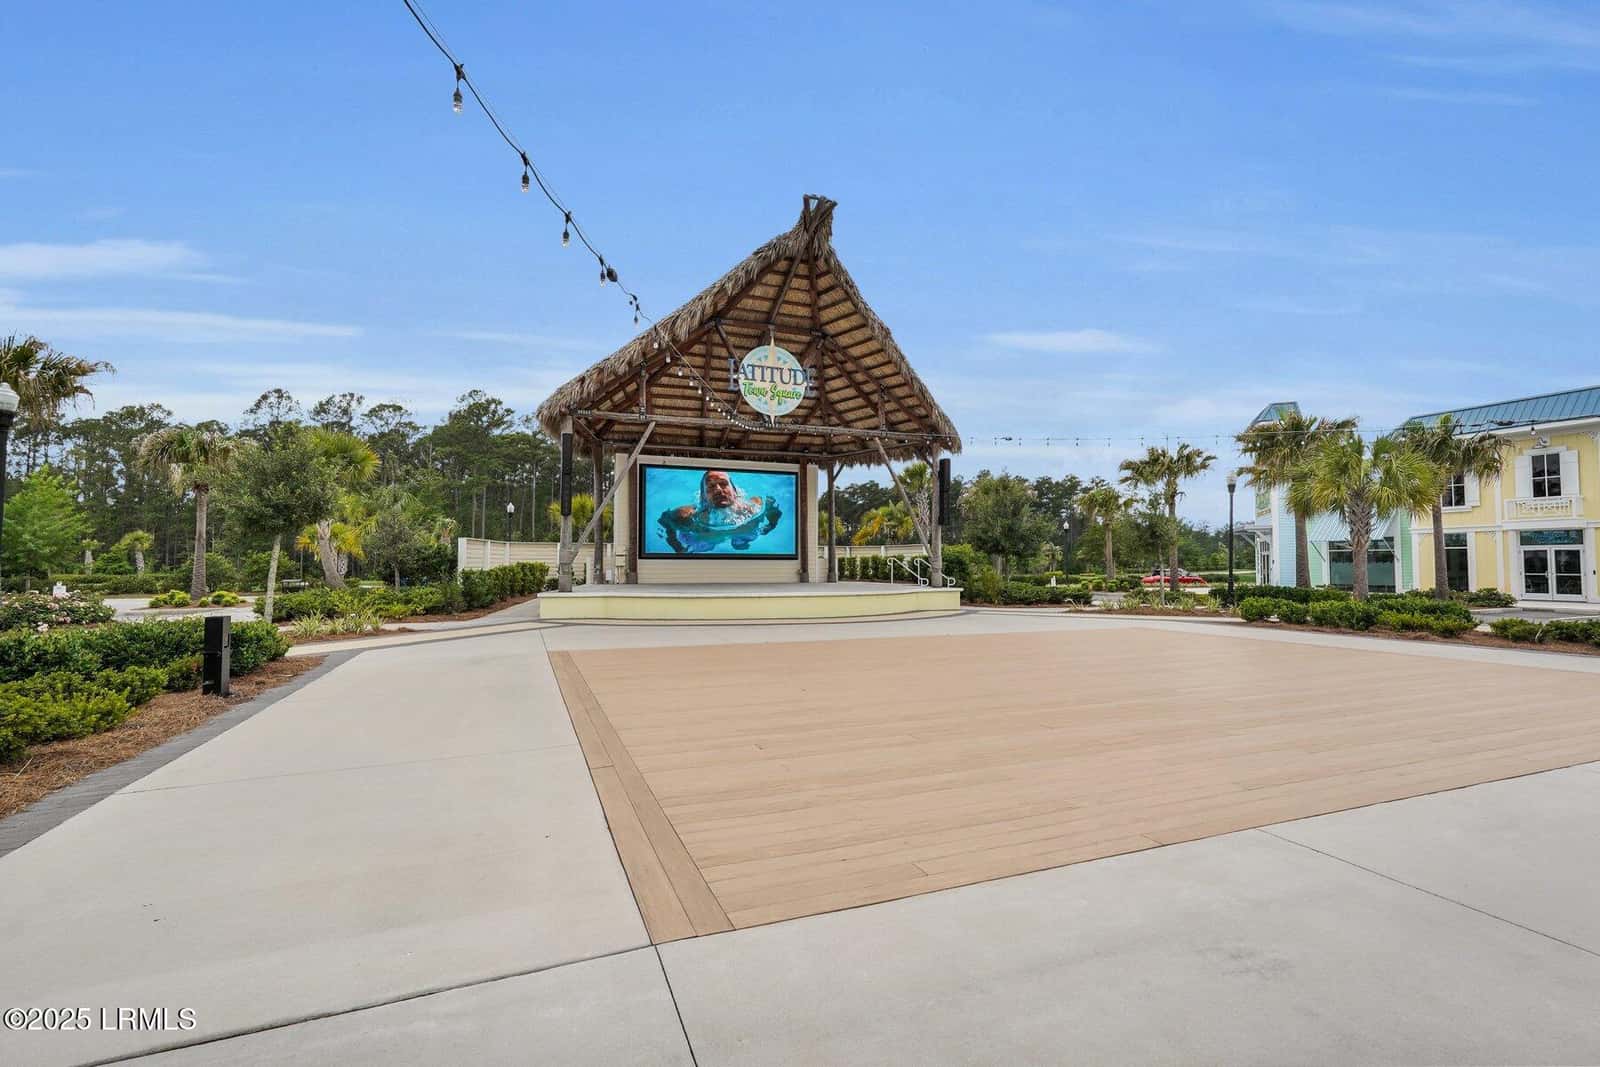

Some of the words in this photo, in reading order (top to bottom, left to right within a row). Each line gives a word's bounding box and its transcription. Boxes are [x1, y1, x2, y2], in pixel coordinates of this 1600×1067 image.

[727, 358, 817, 397] LATITUDE
[743, 381, 767, 397] Town
[768, 383, 803, 406] Square
